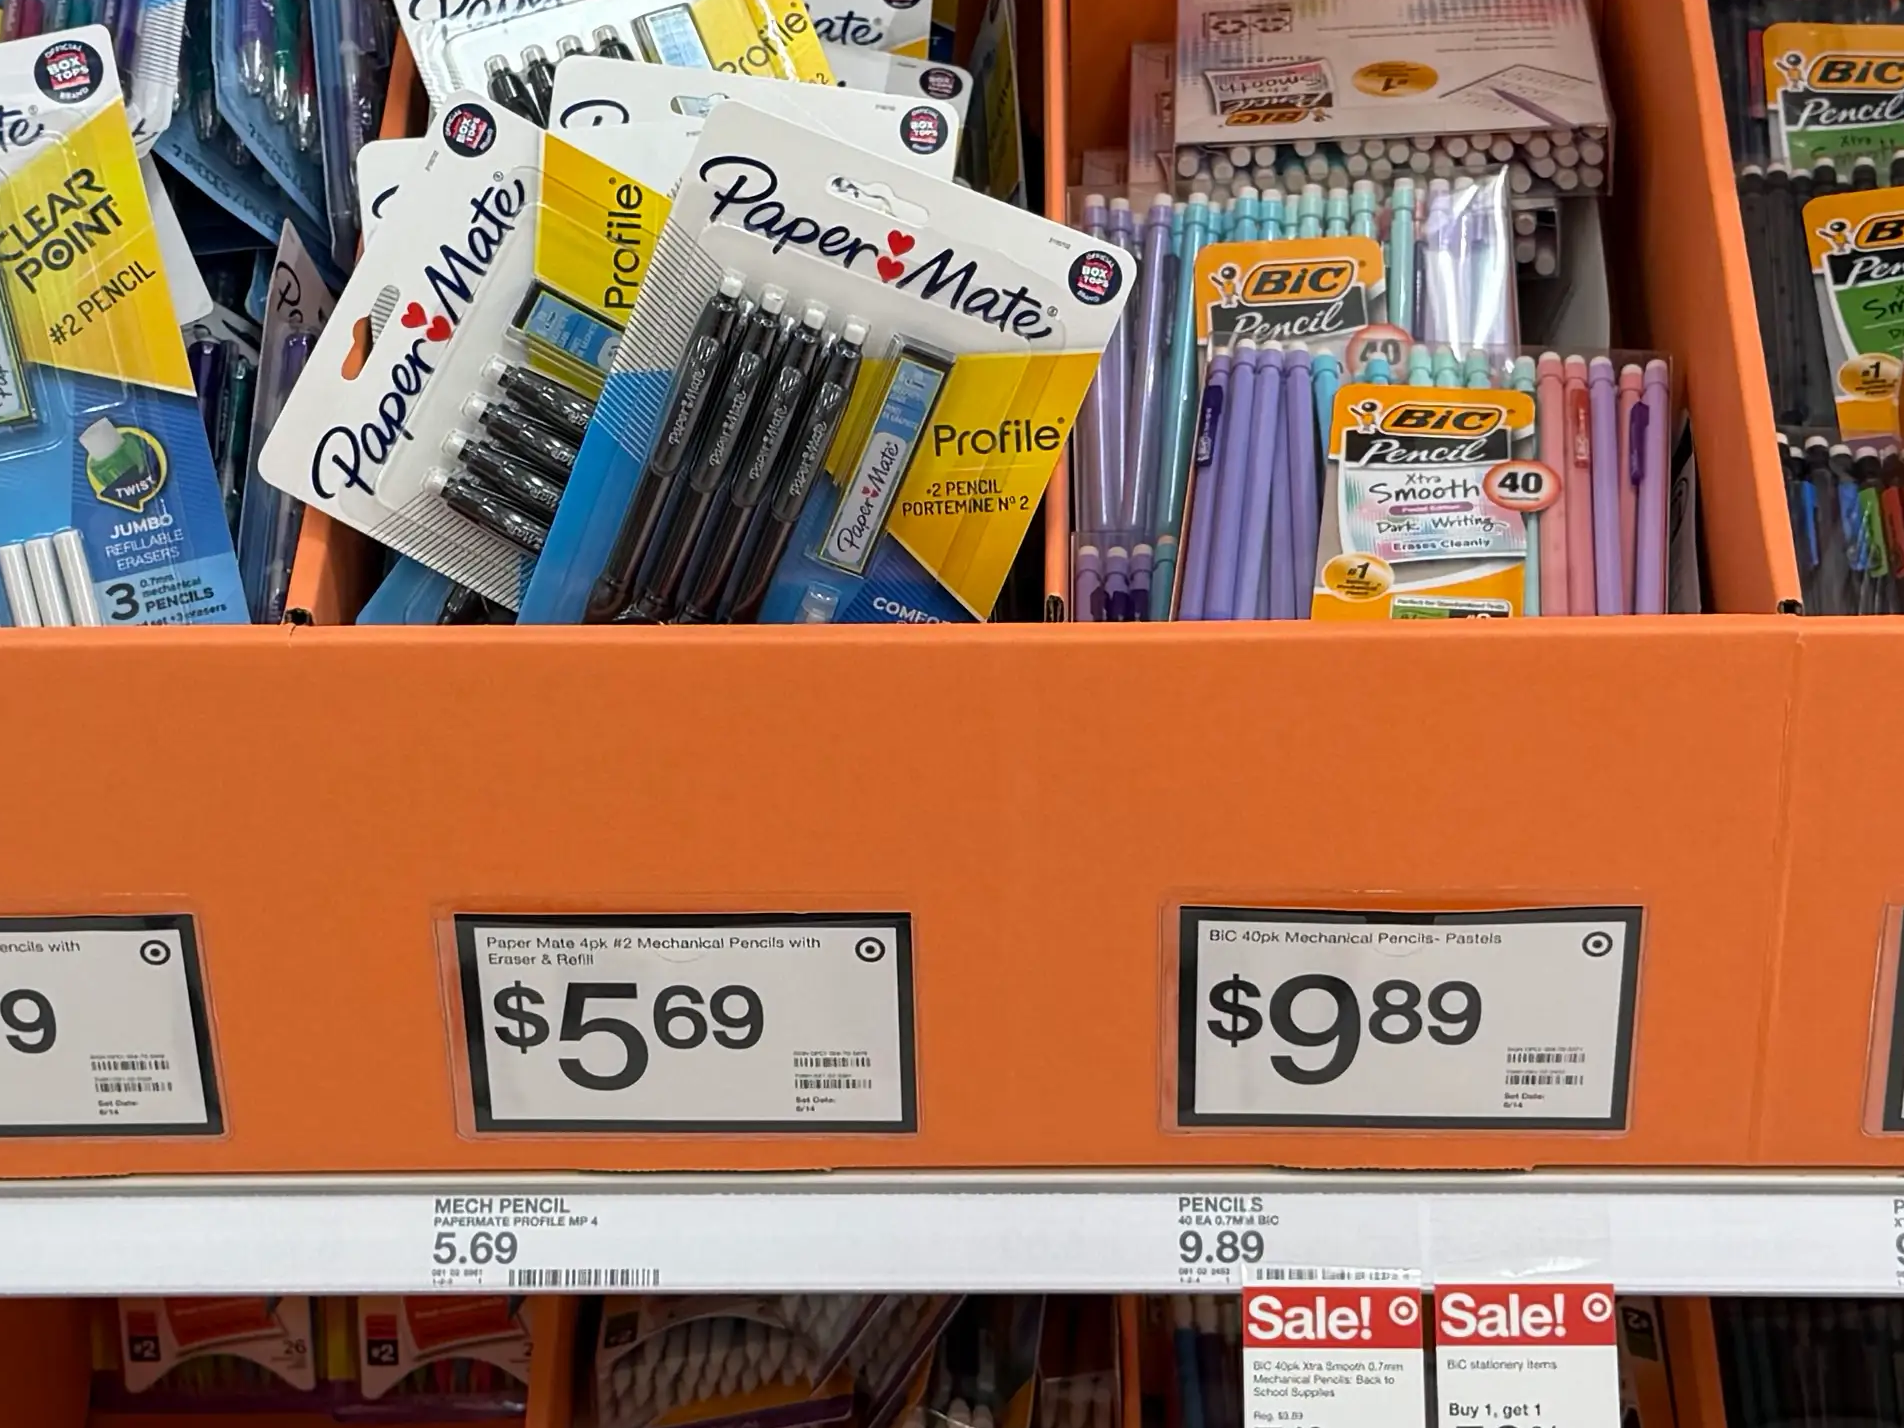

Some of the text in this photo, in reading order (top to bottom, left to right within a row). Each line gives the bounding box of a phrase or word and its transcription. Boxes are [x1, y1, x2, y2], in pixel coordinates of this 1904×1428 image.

[15, 196, 123, 294] POINT
[605, 182, 644, 310] Profile
[700, 156, 1056, 342] Paper Mate
[49, 262, 156, 346] #2 PENCIL
[312, 179, 526, 504] Paper Mate
[933, 419, 1061, 457] Profile
[1360, 437, 1487, 464] Pencil
[1368, 478, 1481, 505] Smooth
[1497, 471, 1543, 494] 40
[901, 496, 998, 519] PORTEMINE
[110, 514, 174, 540] JUMBO
[486, 936, 821, 952] Paper Mate 4pk #2 Mechanical Pencils with
[1241, 930, 1280, 945] 40pk
[1284, 931, 1373, 945] Mechanical
[1445, 932, 1502, 945] Pastels
[487, 952, 594, 966] Eraser & Refill
[434, 1197, 571, 1215] MECH PENCIL
[433, 1215, 566, 1228] PAPERMATE PROFILE
[432, 1231, 518, 1265] 5.69
[1248, 1296, 1373, 1340] Sale!
